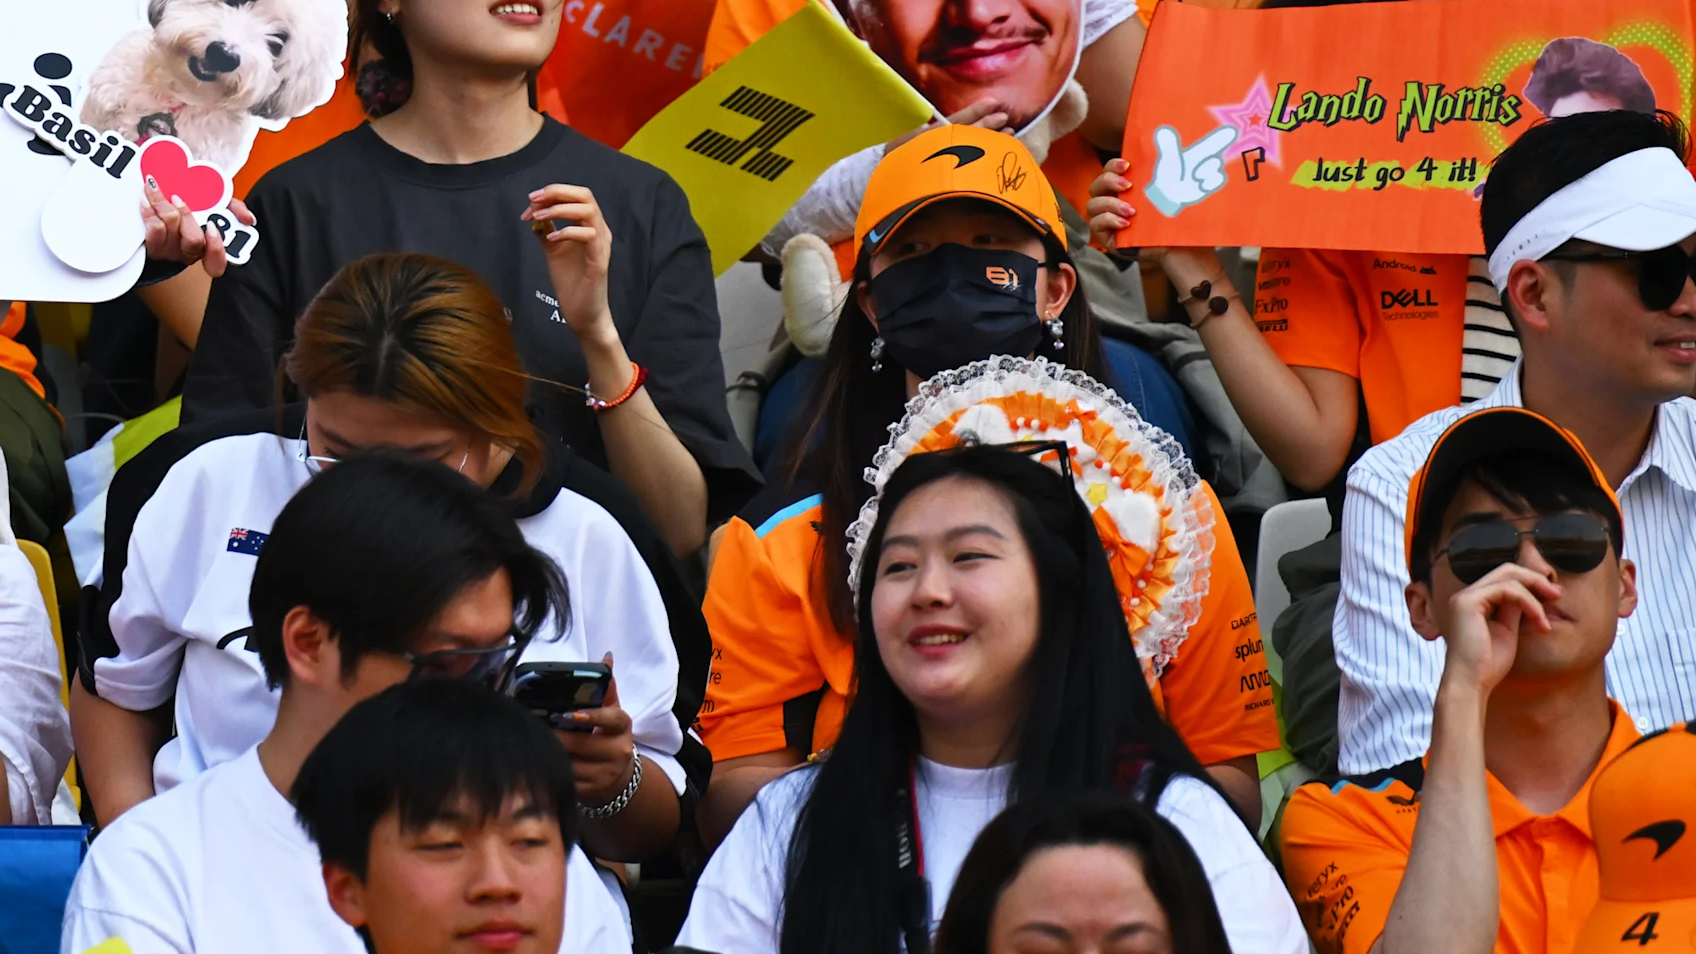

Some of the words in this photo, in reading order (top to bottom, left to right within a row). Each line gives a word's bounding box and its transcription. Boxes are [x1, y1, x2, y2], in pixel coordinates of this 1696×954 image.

[1267, 76, 1387, 133] Lando
[1396, 80, 1523, 142] Norris
[11, 85, 137, 179] Basil
[1312, 157, 1368, 182] Just
[1373, 165, 1405, 191] go
[1417, 156, 1438, 181] 4
[1448, 156, 1477, 182] it!
[1373, 258, 1417, 272] Android
[1381, 289, 1439, 309] DELL
[1382, 309, 1440, 322] Technologies
[1620, 911, 1661, 947] 4
